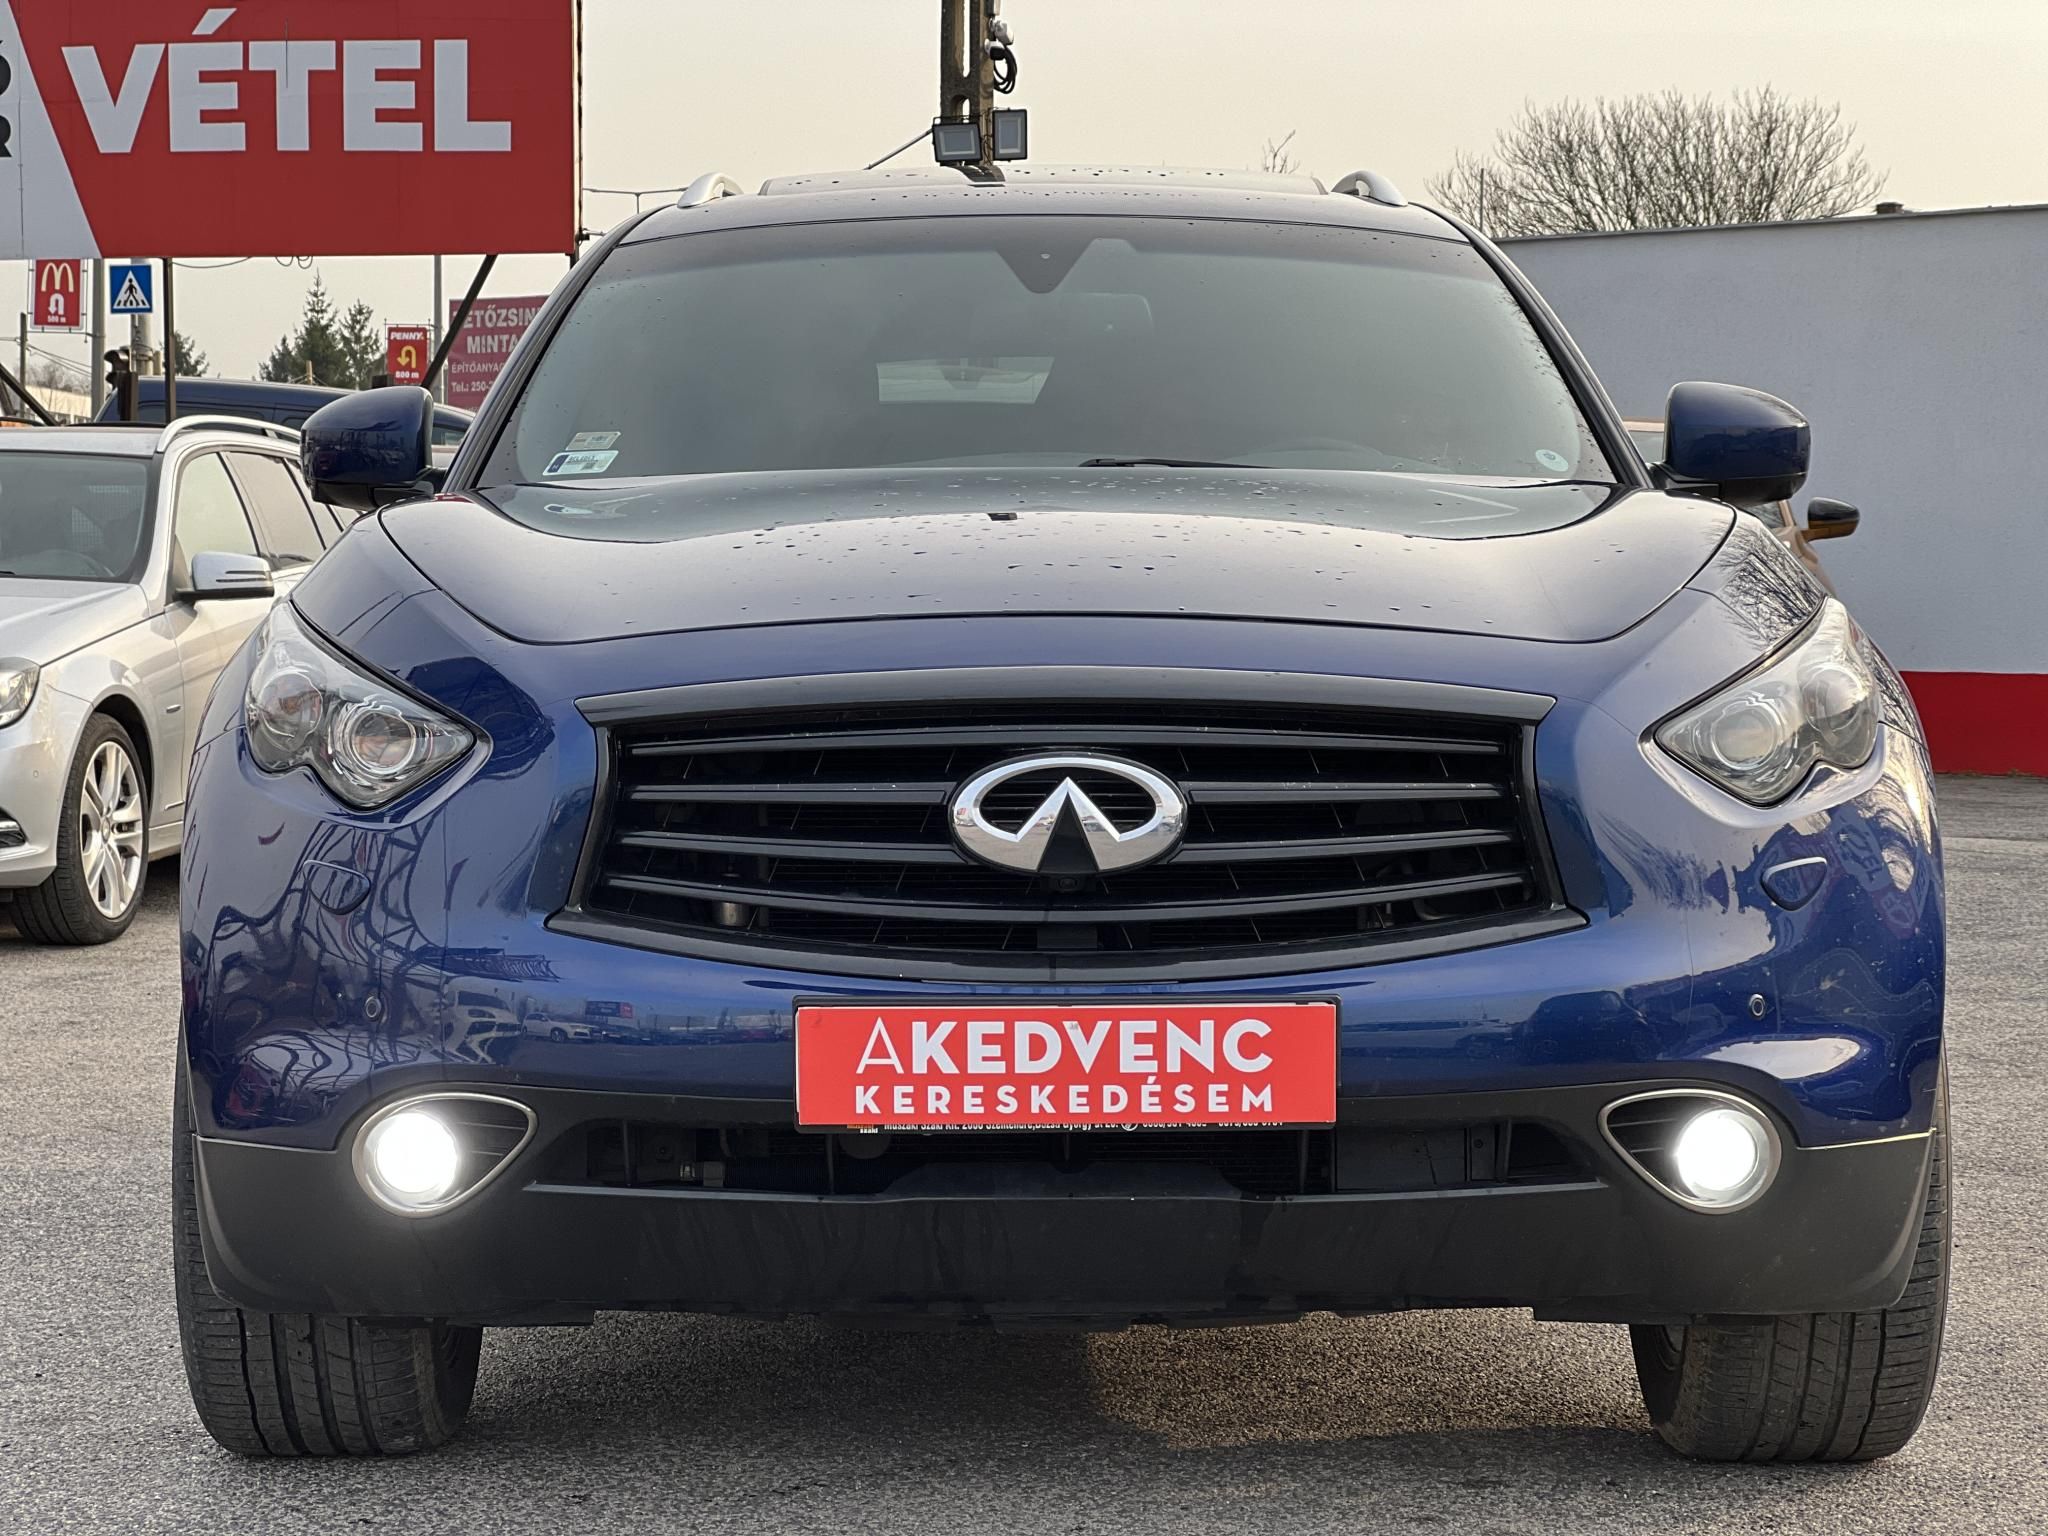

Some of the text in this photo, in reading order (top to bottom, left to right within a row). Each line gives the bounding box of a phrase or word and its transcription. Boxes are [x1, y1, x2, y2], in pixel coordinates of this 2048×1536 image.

[62, 8, 511, 153] VÉTEL
[453, 304, 541, 329] ETŐZSIN
[855, 1075, 1273, 1114] KERESKEDÉSEM
